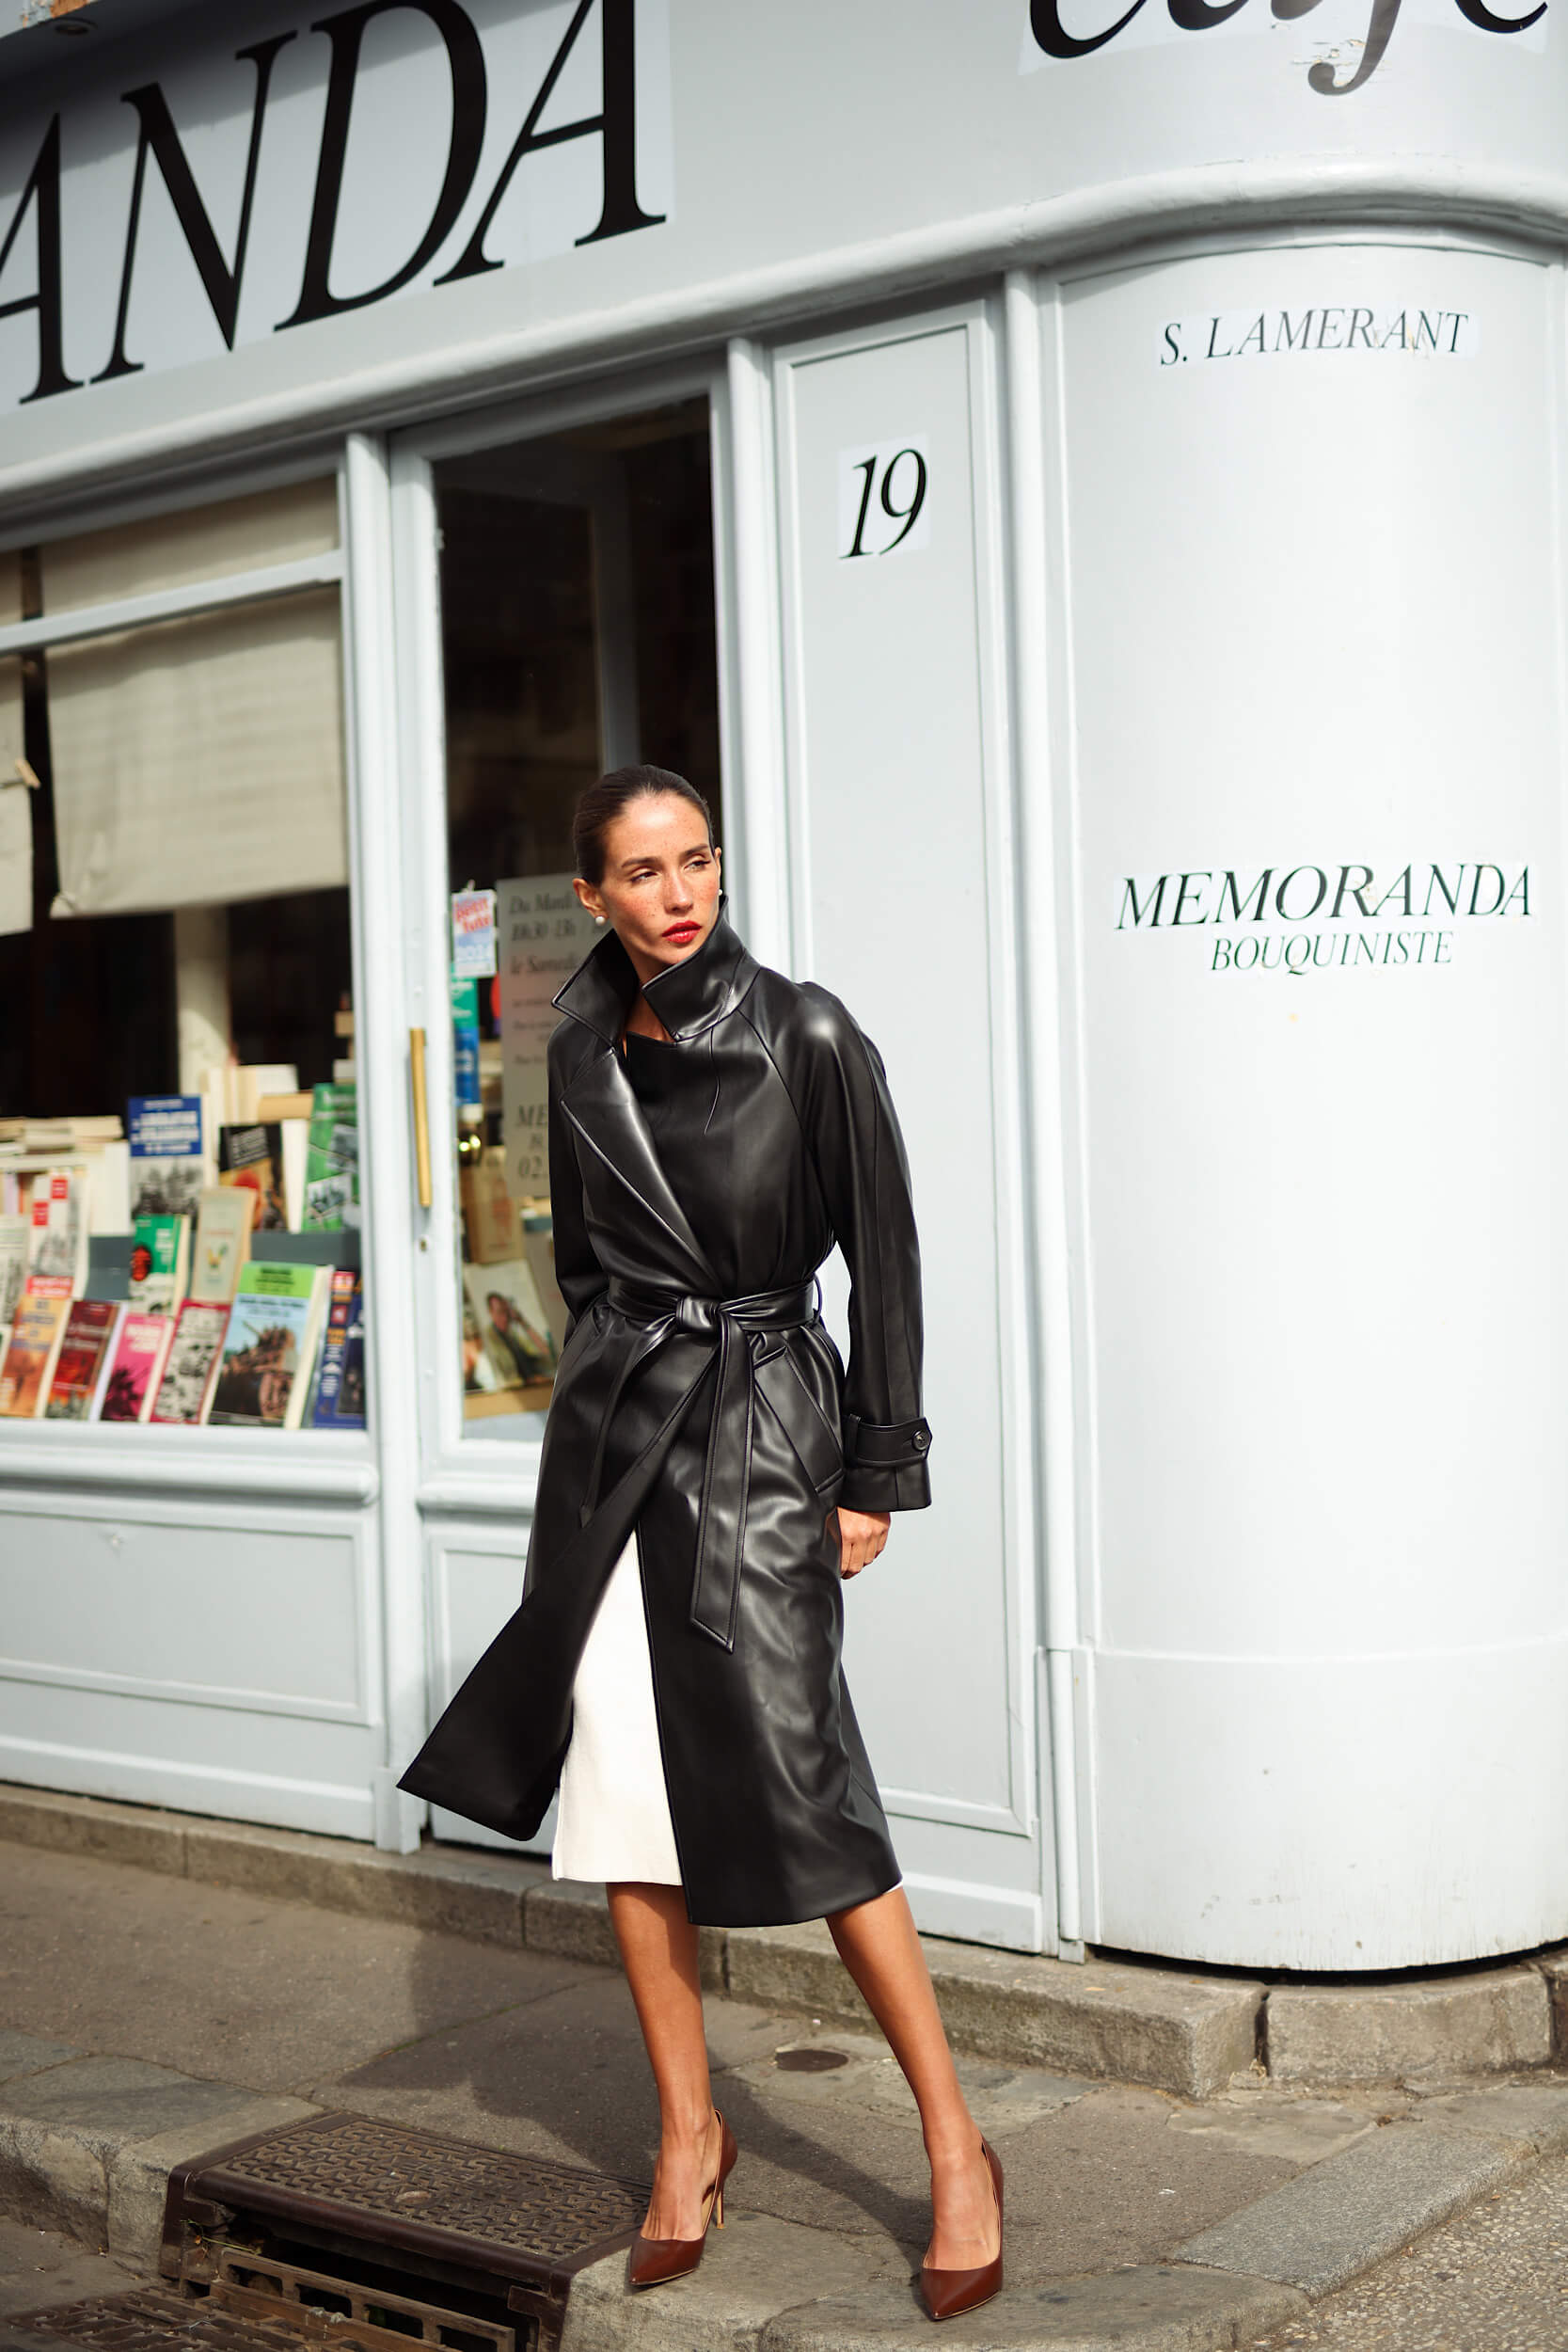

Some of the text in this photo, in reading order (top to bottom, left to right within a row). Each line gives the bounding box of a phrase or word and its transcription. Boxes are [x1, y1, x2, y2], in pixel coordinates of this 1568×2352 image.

[1160, 308, 1468, 365] S. LAMERANT
[838, 448, 927, 559] 19
[1115, 864, 1533, 930] MEMORANDA
[1212, 930, 1453, 975] BOUQUINISTE
